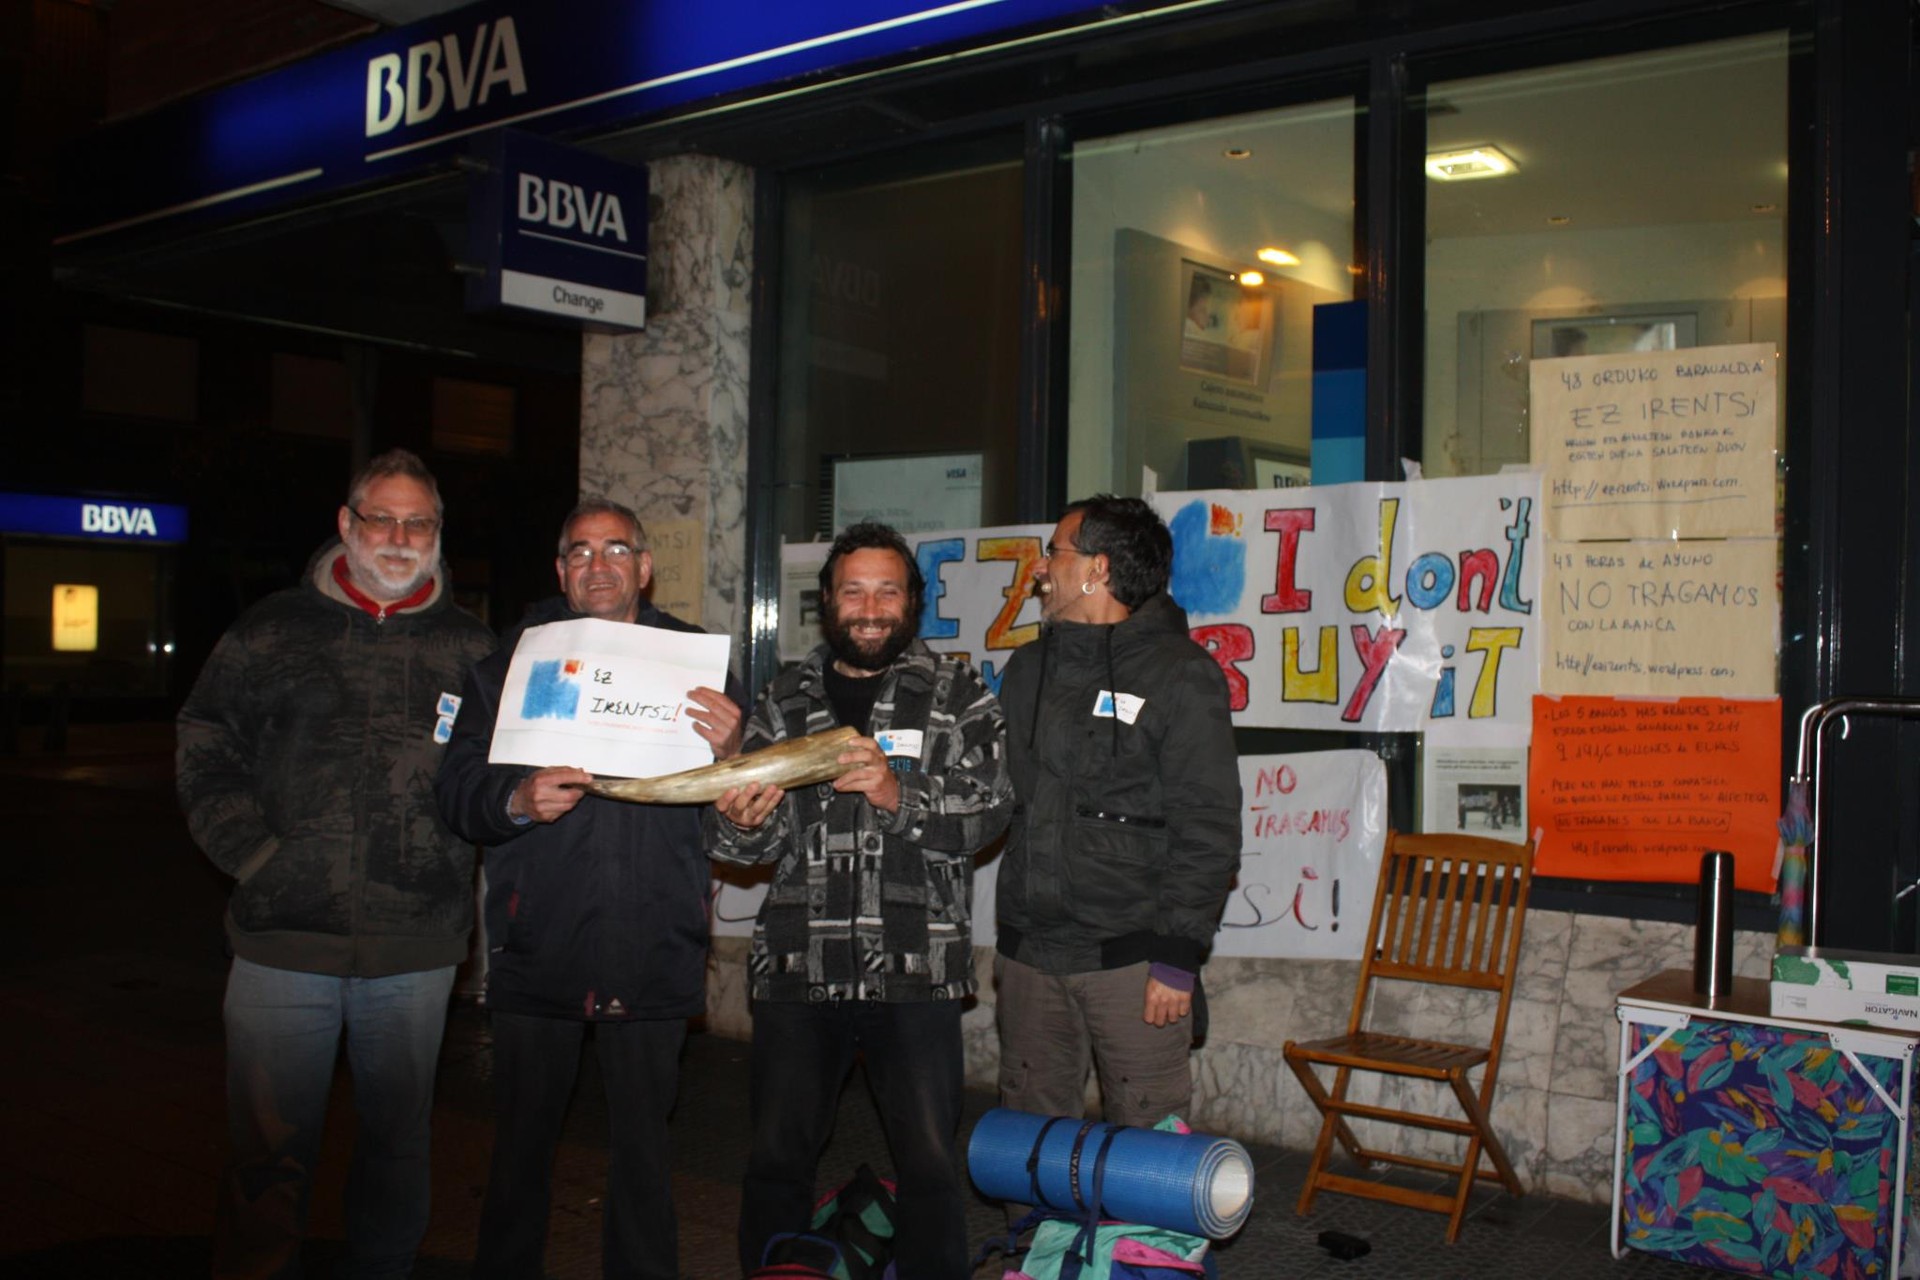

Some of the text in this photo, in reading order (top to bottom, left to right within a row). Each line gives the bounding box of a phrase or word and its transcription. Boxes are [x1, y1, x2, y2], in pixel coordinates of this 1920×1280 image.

[365, 15, 528, 138] BBVA
[518, 173, 628, 242] BBVA
[552, 284, 604, 314] Change
[1562, 371, 1582, 390] 48
[1593, 367, 1658, 385] ORDUKO
[1570, 404, 1621, 428] EZ
[946, 468, 967, 479] VISA
[82, 504, 157, 536] BBVA
[1261, 507, 1316, 614] I
[1553, 555, 1573, 570] 48
[1586, 555, 1625, 568] HORAS
[1663, 554, 1714, 568] AYUNO
[914, 536, 1043, 651] EZ
[1560, 579, 1759, 615] NO TRAGAMOS
[1568, 619, 1594, 632] CON
[1256, 764, 1297, 798] NO
[1250, 805, 1351, 843] TRAGAMOS
[1864, 1003, 1919, 1019] NAVIGATOR
